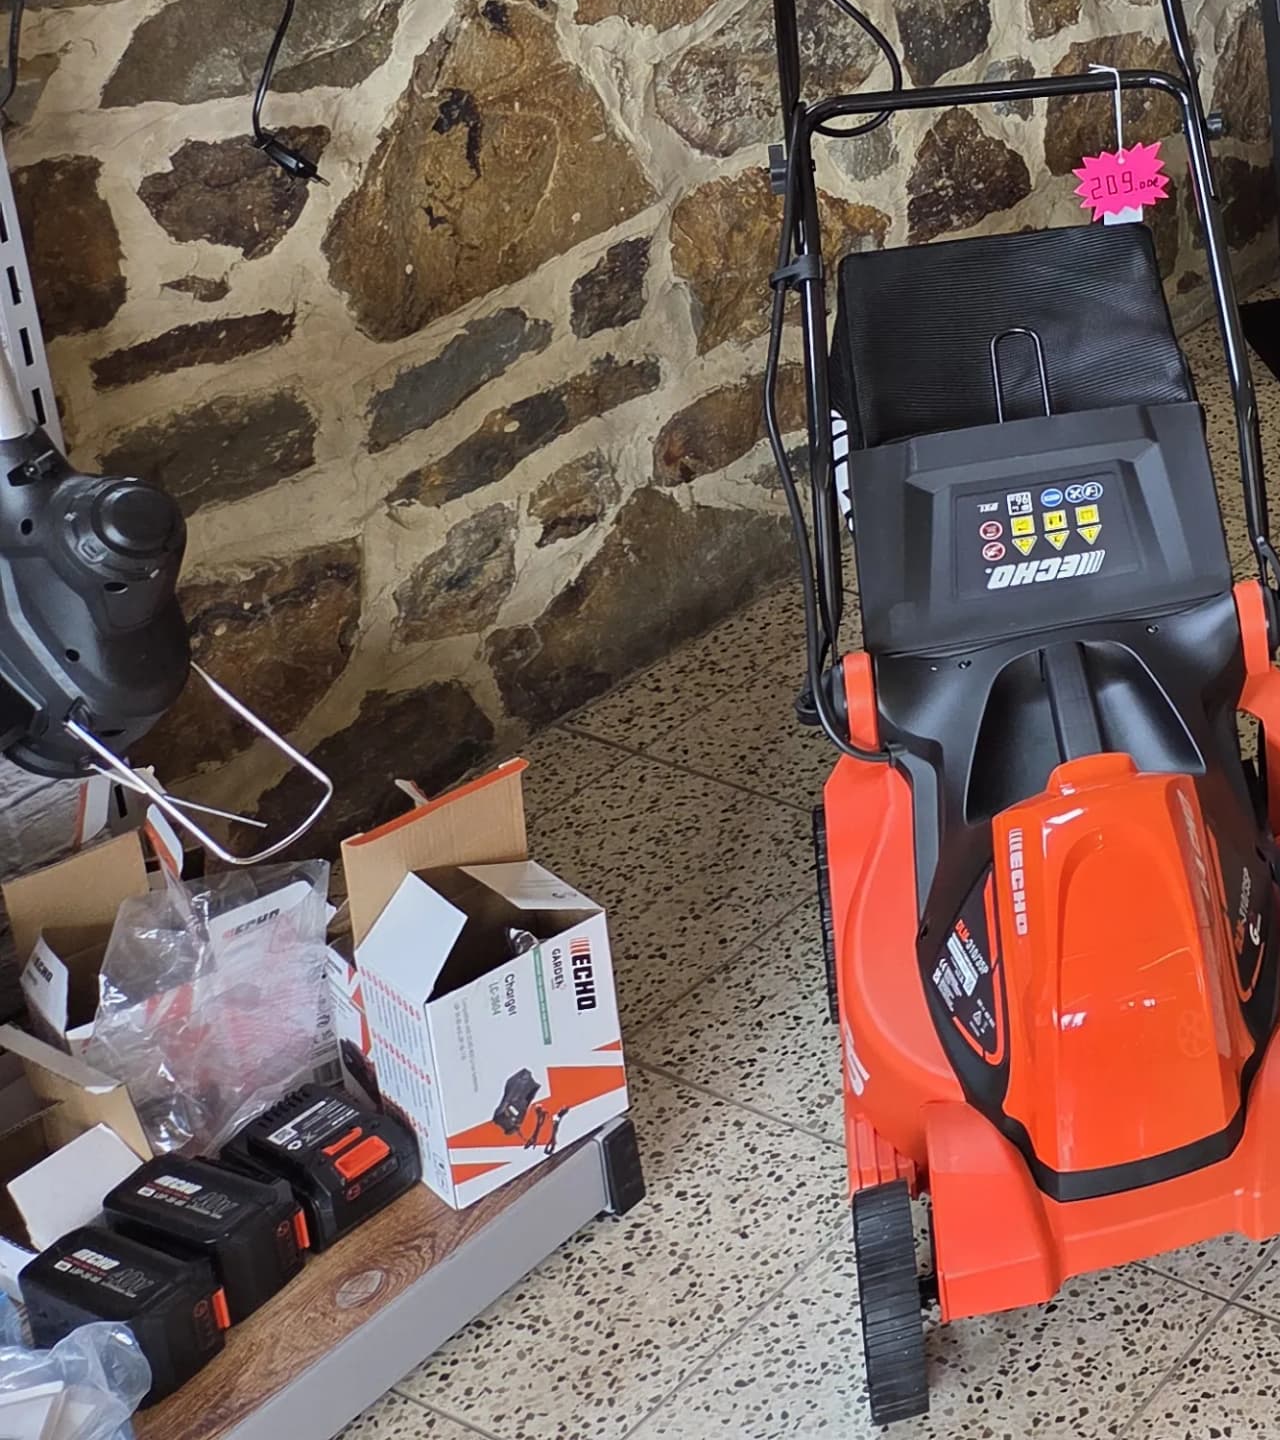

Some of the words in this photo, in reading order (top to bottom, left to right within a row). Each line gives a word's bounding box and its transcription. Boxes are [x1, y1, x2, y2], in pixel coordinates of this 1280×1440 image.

[987, 553, 1103, 591] ECHO
[1009, 834, 1028, 936] ECHO
[504, 973, 518, 1017] Charger
[570, 944, 597, 1012] ECHO
